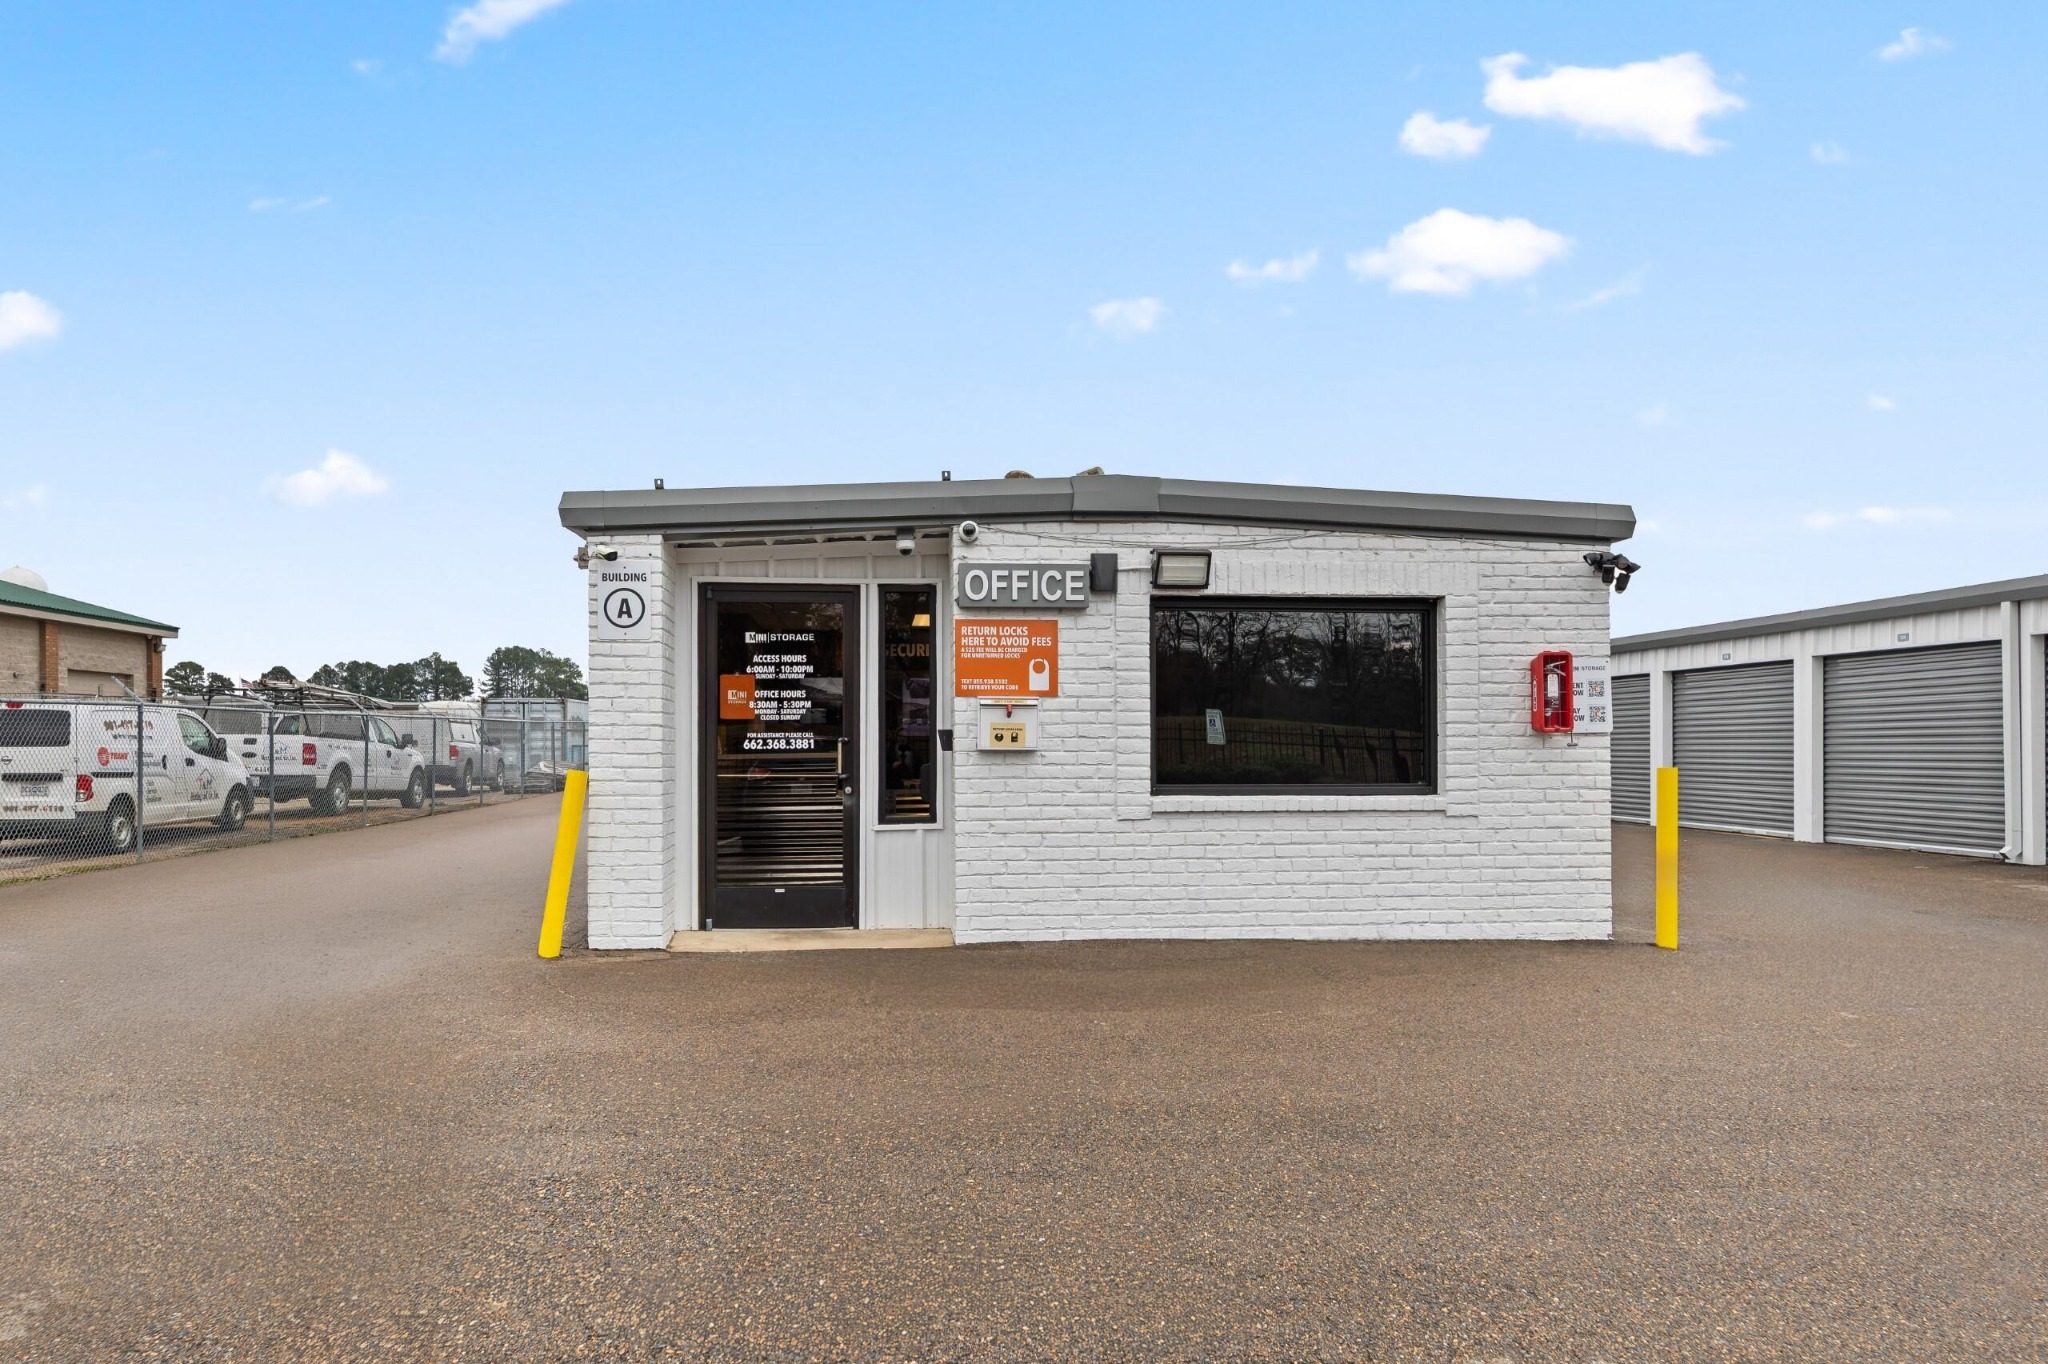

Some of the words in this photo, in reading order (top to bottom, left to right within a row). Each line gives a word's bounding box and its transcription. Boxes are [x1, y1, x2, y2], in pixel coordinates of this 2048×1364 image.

[602, 573, 647, 582] BUILDING
[964, 569, 1085, 601] OFFICE
[617, 598, 633, 619] A
[961, 626, 997, 636] RETURN
[999, 626, 1029, 636] LOCKS
[745, 631, 767, 644] MINI
[770, 633, 815, 641] STORAGE
[961, 637, 985, 646] HERE
[986, 637, 998, 646] TO
[1000, 637, 1030, 646] AVOID
[1031, 637, 1052, 647] FEES
[753, 654, 780, 663] ACCESS
[781, 654, 807, 663] HOURS
[746, 665, 775, 673] 6:00AM
[781, 665, 814, 673] 10:00PM
[754, 690, 779, 698] OFFICE
[780, 690, 806, 698] HOURS
[749, 700, 778, 709] 8:30AM
[783, 700, 812, 709] 5:30PM
[743, 739, 815, 749] 662.368.3881
